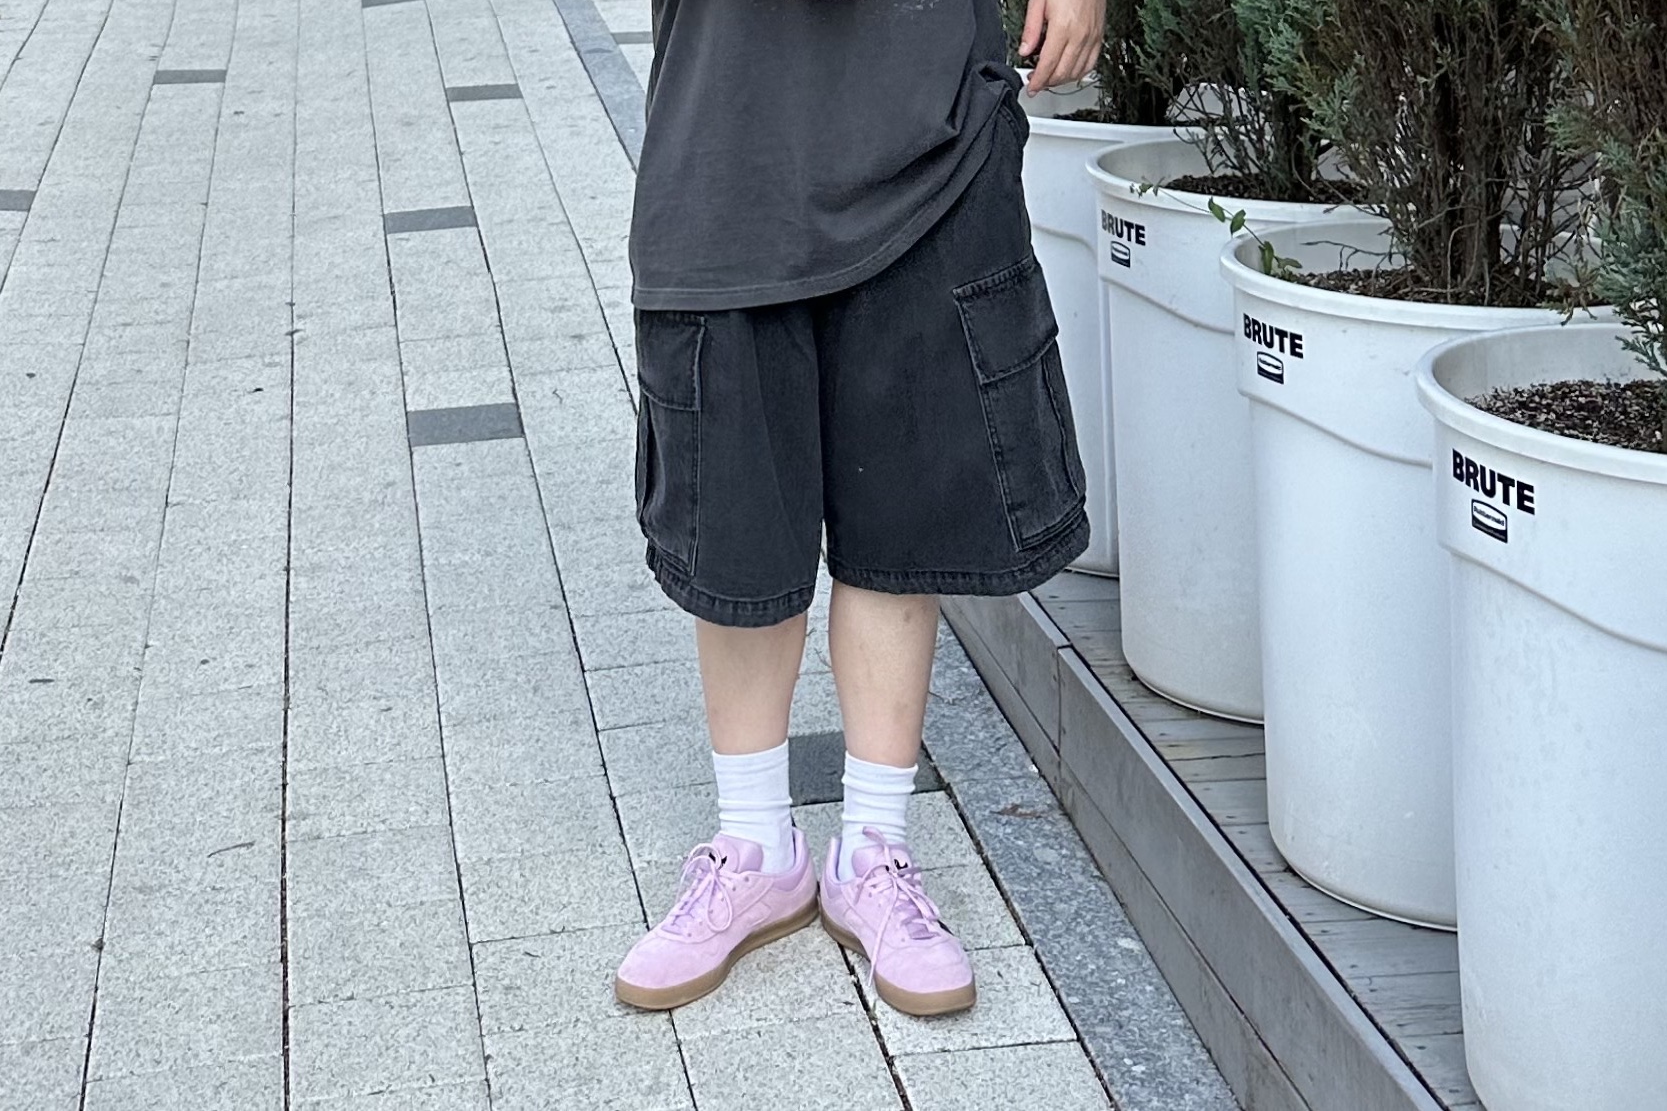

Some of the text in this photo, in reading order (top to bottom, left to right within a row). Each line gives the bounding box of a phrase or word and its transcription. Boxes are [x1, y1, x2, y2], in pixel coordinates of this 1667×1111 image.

[1101, 209, 1146, 246] BRUTE
[1243, 312, 1304, 359] BRUTE
[1452, 447, 1536, 516] BRUTE
